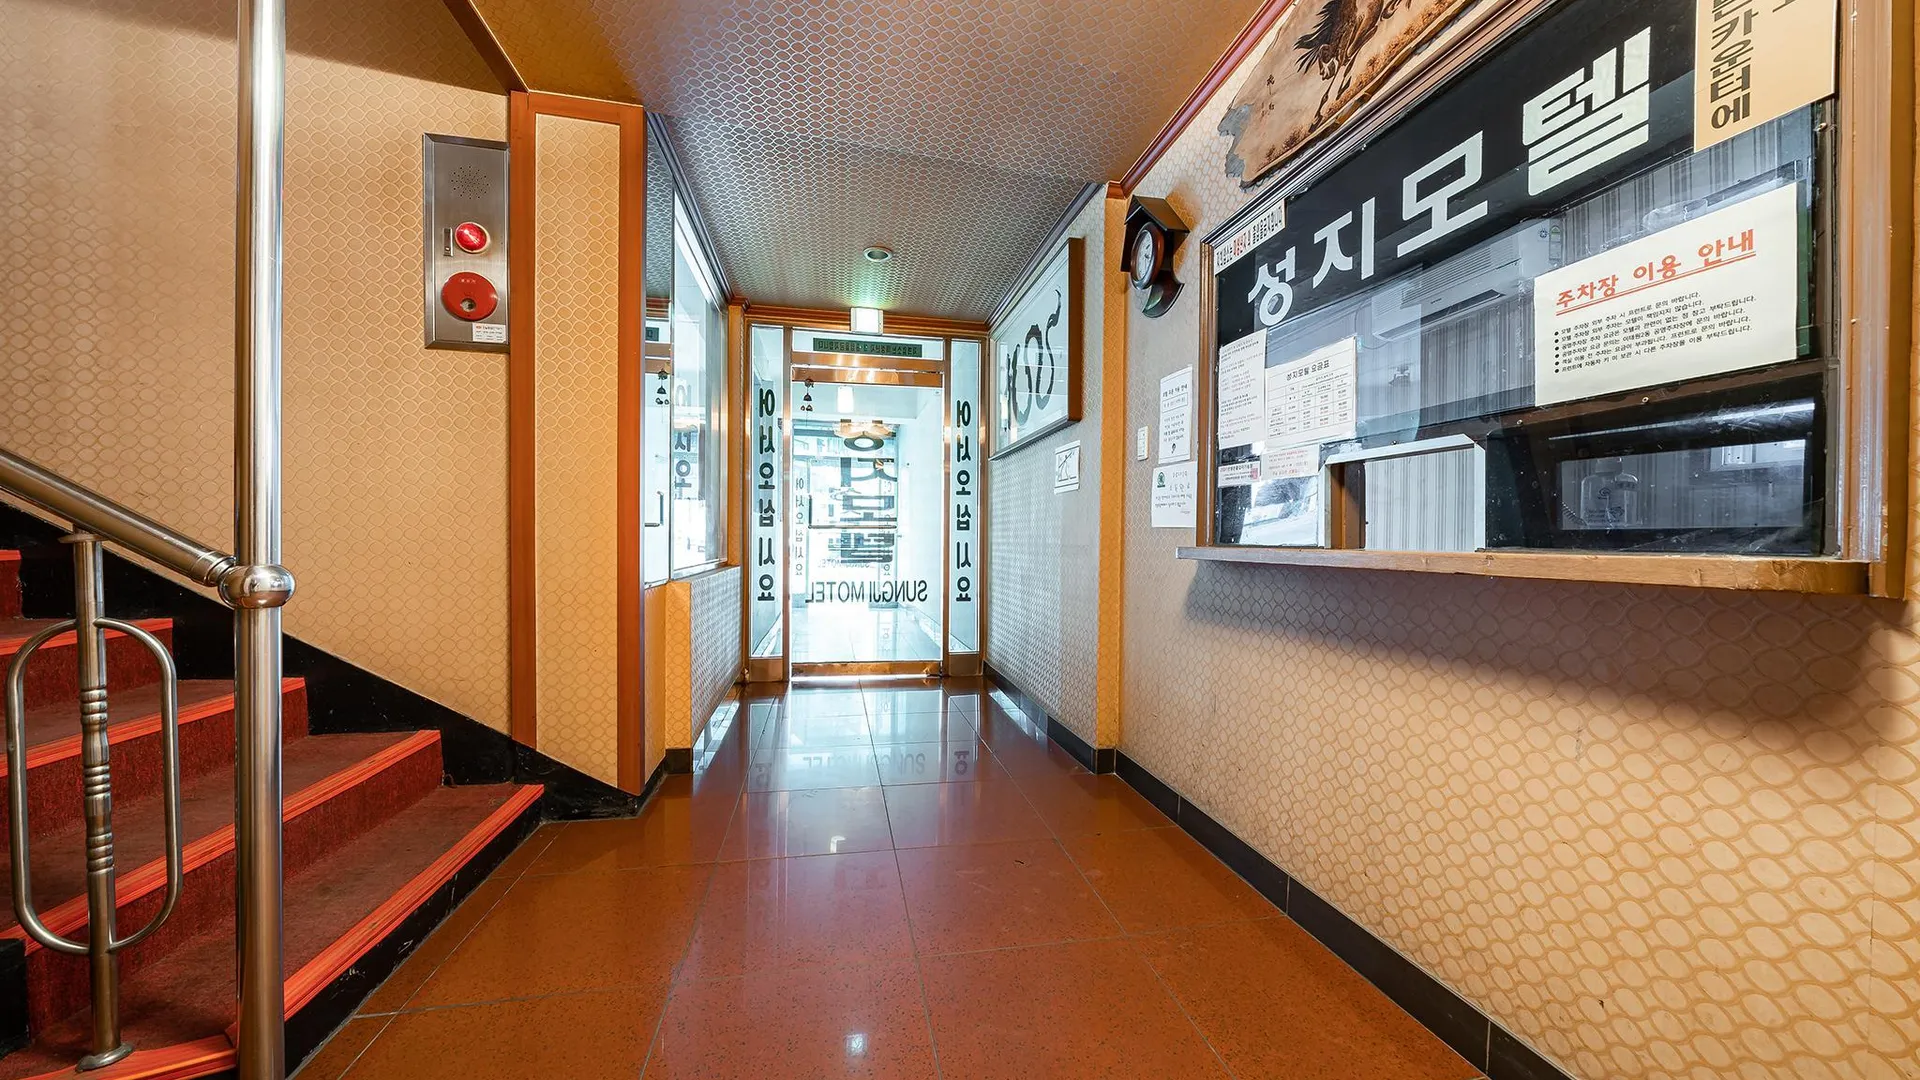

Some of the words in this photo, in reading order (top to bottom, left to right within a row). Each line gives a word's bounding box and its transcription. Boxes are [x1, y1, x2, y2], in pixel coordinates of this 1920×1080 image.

[1248, 26, 1651, 327] 성지모텔
[1555, 274, 1618, 308] 주차장
[1632, 254, 1681, 281] 이용
[1697, 229, 1754, 267] 안내
